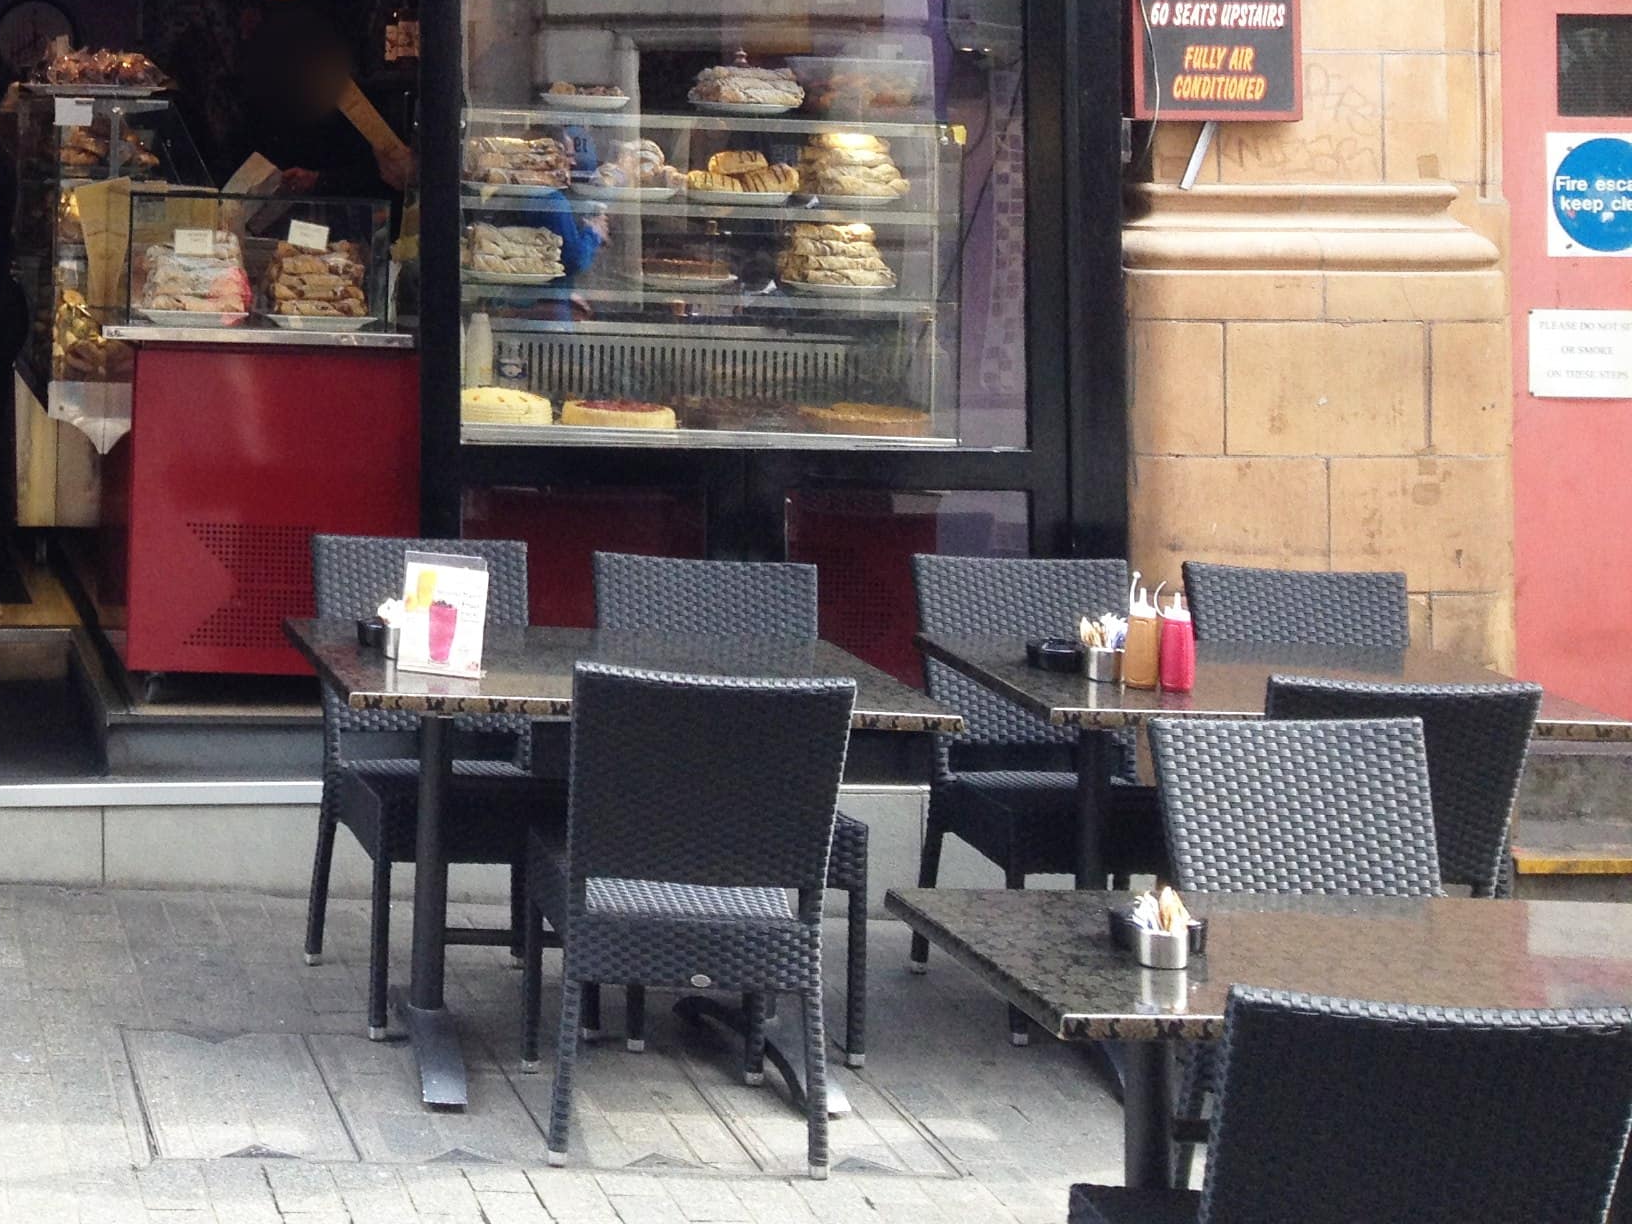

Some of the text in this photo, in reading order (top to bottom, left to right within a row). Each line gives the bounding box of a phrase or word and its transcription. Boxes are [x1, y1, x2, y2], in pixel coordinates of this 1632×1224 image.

[1151, 2, 1285, 27] 60 SEATS UPSTAIRS
[1184, 46, 1254, 71] FULLY AIR
[1173, 76, 1265, 100] CONDITIONED
[1556, 176, 1588, 191] Fire
[1560, 195, 1604, 212] keep
